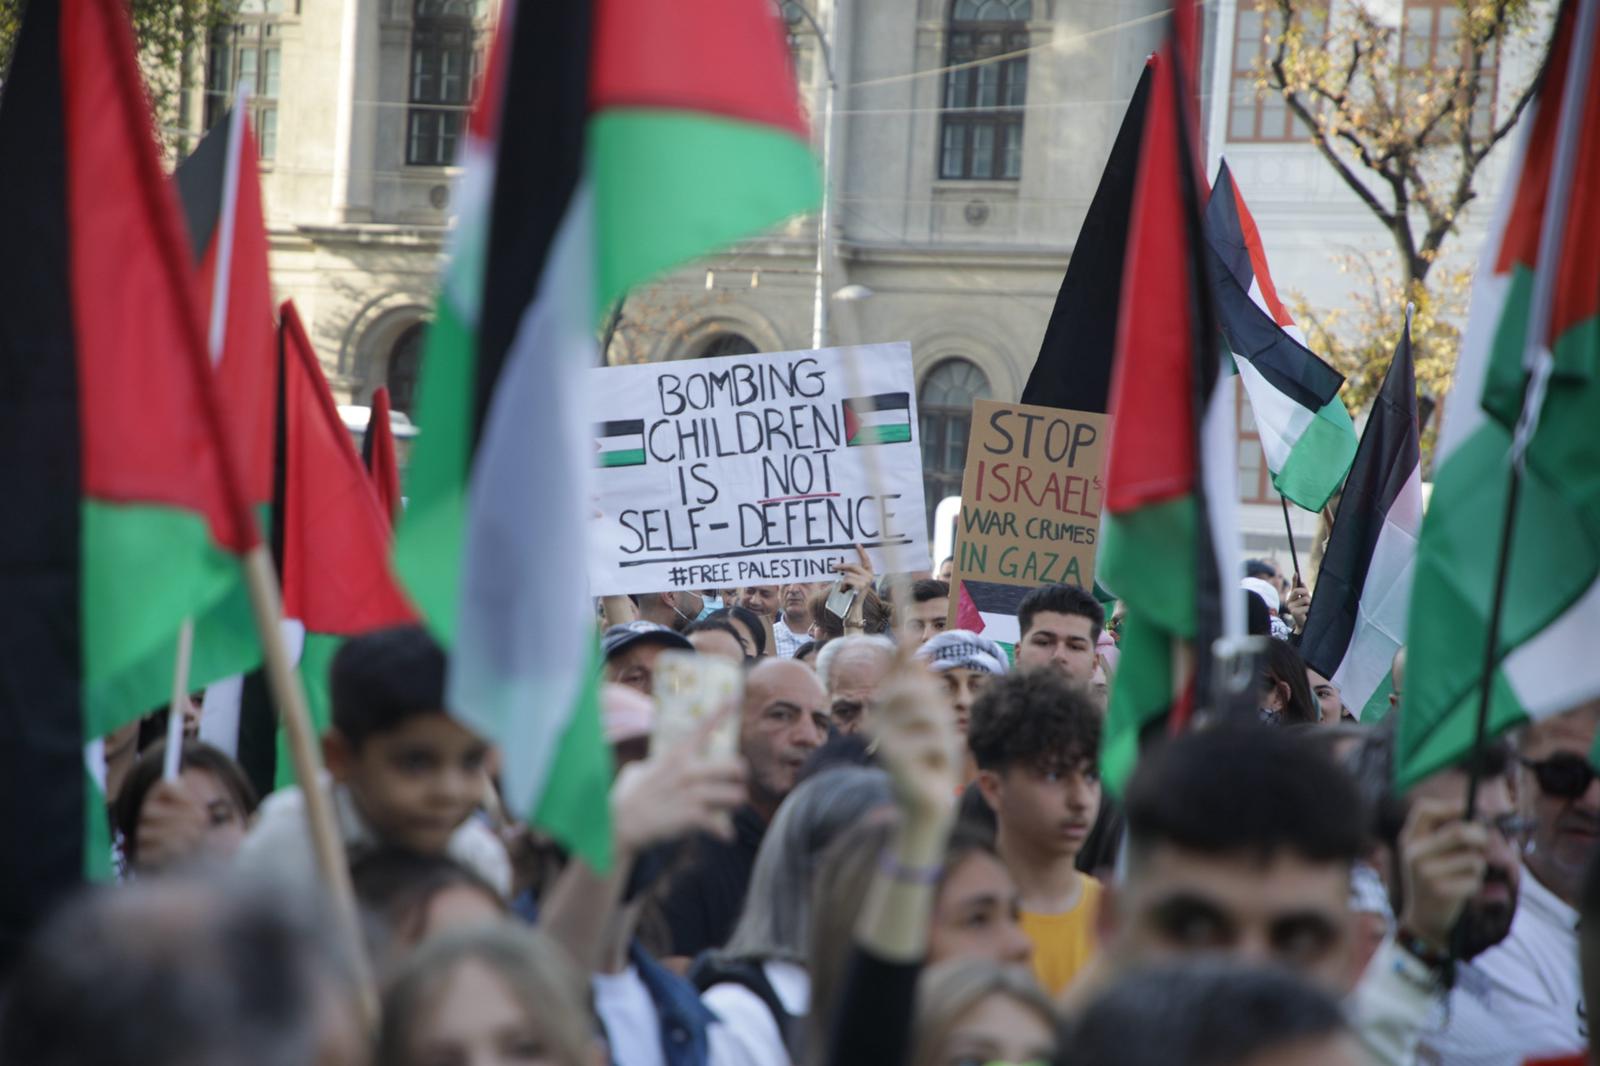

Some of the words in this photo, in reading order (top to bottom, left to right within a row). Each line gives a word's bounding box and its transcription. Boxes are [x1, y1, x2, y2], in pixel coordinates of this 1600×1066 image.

[658, 359, 825, 416] BOMBING
[649, 404, 839, 462] CHILDREN
[984, 410, 1096, 468] STOP
[678, 464, 719, 505] IS
[762, 449, 836, 498] NOT
[620, 494, 906, 553] SELF-DEFENCE
[963, 506, 1018, 538] WAR
[1026, 517, 1096, 544] CRIMES
[668, 566, 733, 586] #FREE
[739, 556, 845, 580] PALESTINE!
[959, 541, 987, 574] IN
[999, 546, 1082, 585] GAZA
